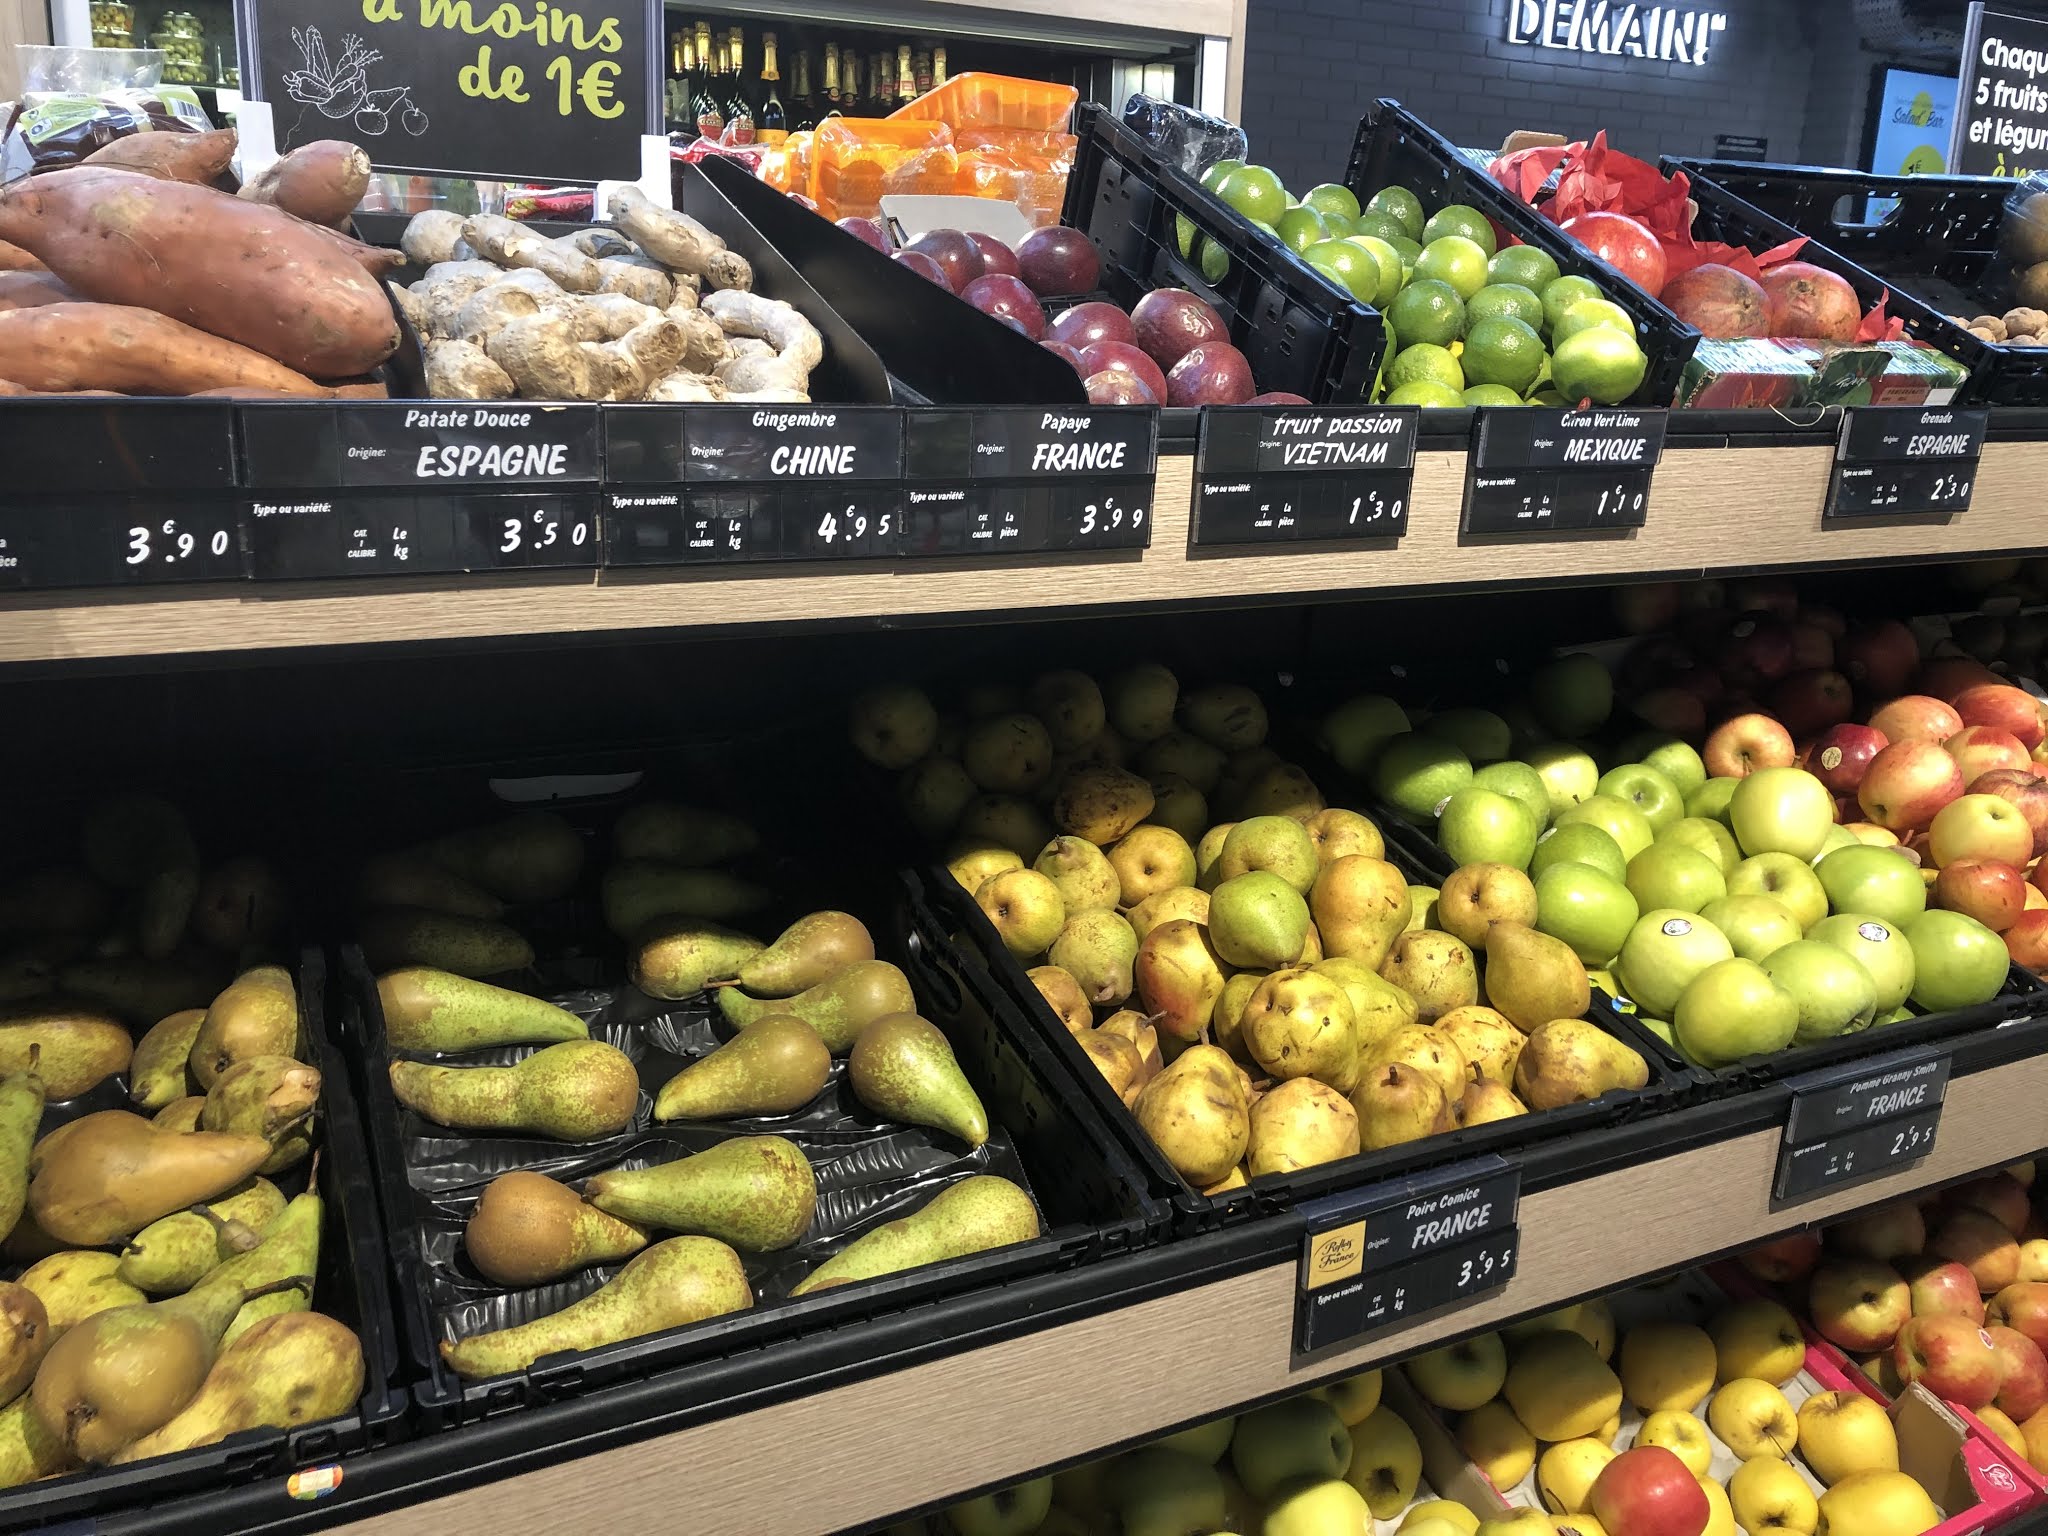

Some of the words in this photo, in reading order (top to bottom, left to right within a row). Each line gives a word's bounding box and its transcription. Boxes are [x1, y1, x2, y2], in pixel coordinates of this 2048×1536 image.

[420, 0, 623, 53] moins
[458, 45, 530, 103] de
[546, 55, 625, 119] 1€
[1975, 77, 1990, 105] 5
[1993, 79, 2048, 113] fruits
[1969, 117, 1992, 143] et
[405, 410, 469, 428] Patate
[474, 410, 531, 427] Douce
[752, 411, 837, 432] Gingembre
[1041, 413, 1091, 434] Papaye
[1272, 412, 1323, 436] fruit
[1326, 413, 1402, 437] passion
[1593, 413, 1615, 427] Vert
[1616, 413, 1640, 427] Lime
[1921, 412, 1953, 424] Grenade
[691, 446, 725, 458] Origine:
[977, 444, 1005, 456] Origine:
[1563, 438, 1647, 462] MEXIQUE
[1906, 434, 1970, 455] ESPAGNE
[348, 447, 386, 460] Origine:
[416, 444, 568, 477] ESPAGNE
[770, 445, 857, 476] CHINE
[1031, 442, 1127, 471] FRANCE
[1283, 442, 1388, 465] VIETNAM
[909, 491, 926, 503] Type
[1204, 484, 1219, 495] Type
[612, 496, 632, 508] Type
[646, 495, 678, 505] variété:
[1283, 503, 1291, 512] La
[1542, 495, 1549, 504] La
[252, 503, 277, 517] Type
[279, 506, 291, 514] ou
[293, 502, 331, 513] variété:
[1005, 512, 1014, 522] La
[393, 527, 407, 540] Le
[728, 520, 741, 531] Le
[1000, 526, 1018, 539] pièce
[728, 535, 741, 550] kg
[347, 549, 376, 558] CALIBRE
[393, 544, 408, 560] kg
[1850, 1078, 1881, 1094] Pomme
[1882, 1070, 1913, 1085] Granny
[1913, 1061, 1937, 1077] Smith
[1866, 1083, 1928, 1118] FRANCE
[1406, 1201, 1437, 1219] Poire
[1440, 1188, 1480, 1208] Comice
[1411, 1203, 1492, 1249] FRANCE
[1318, 1252, 1355, 1269] France
